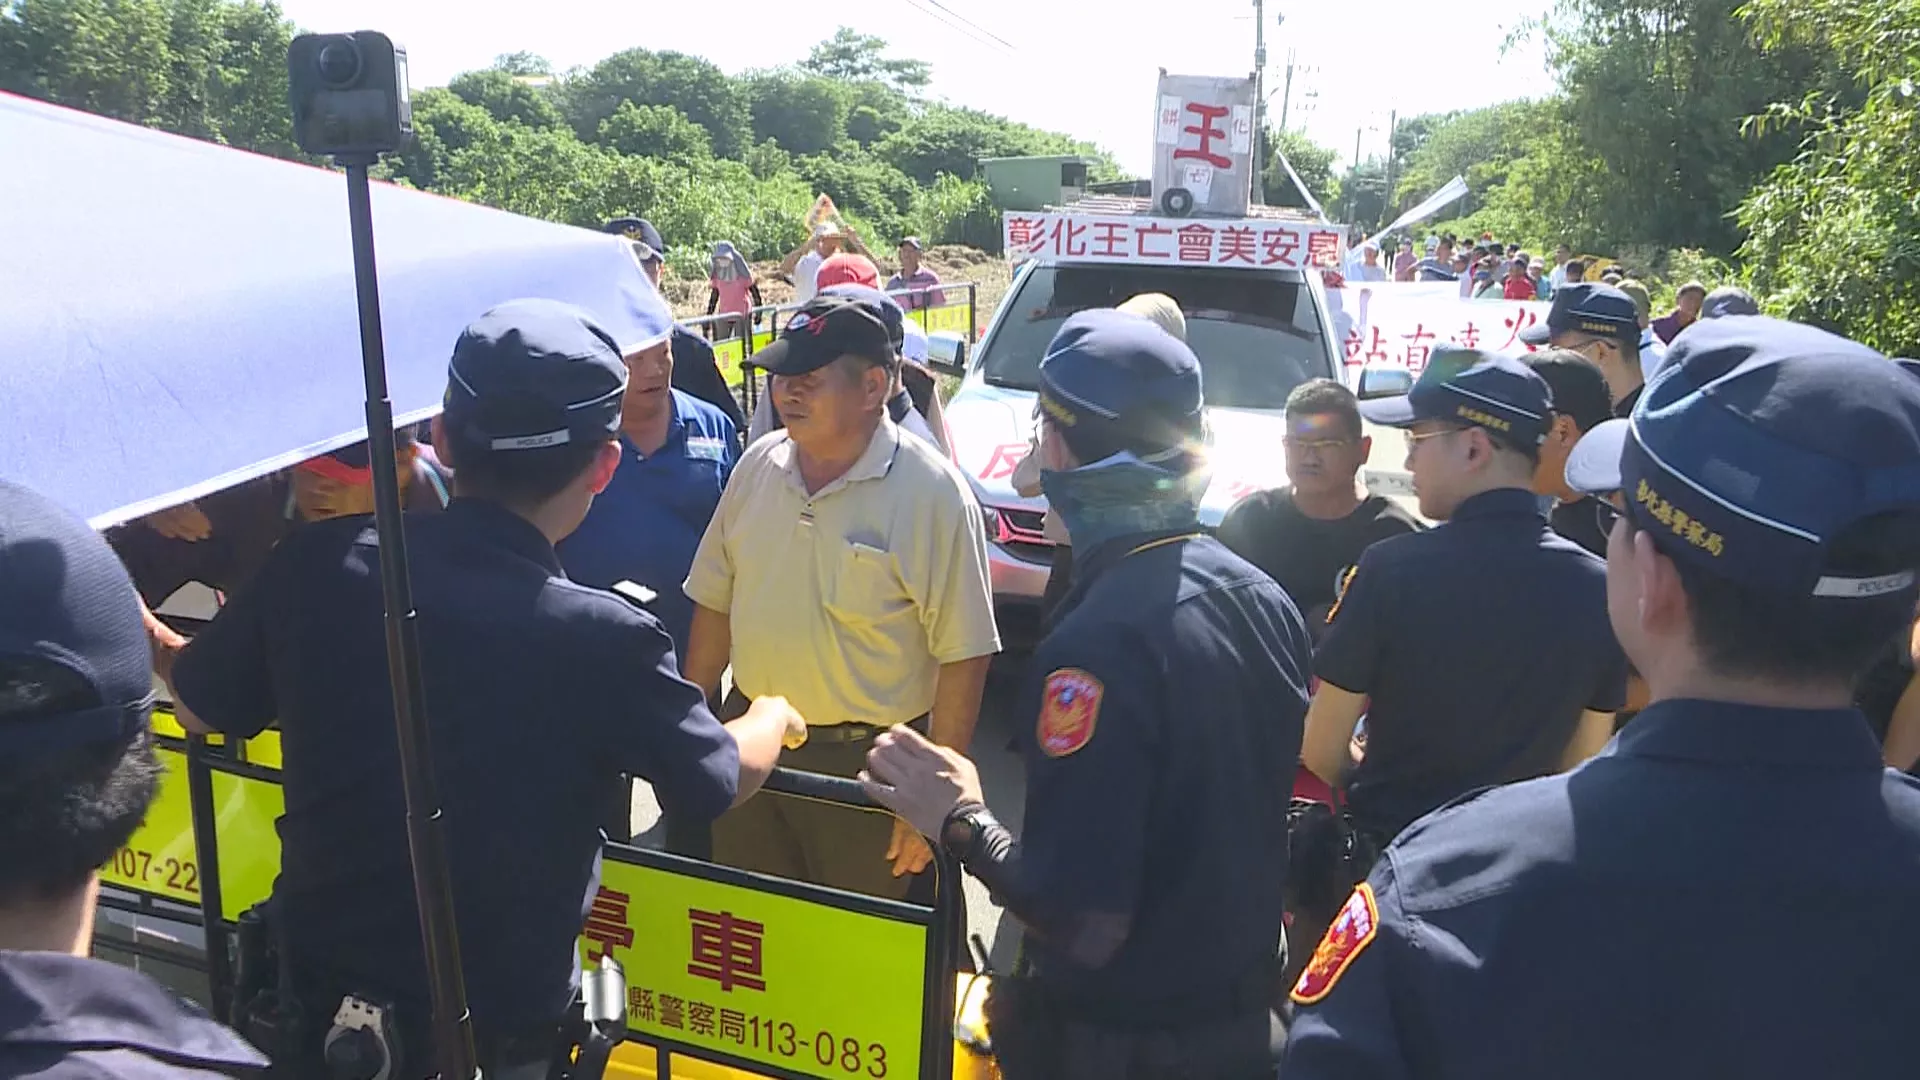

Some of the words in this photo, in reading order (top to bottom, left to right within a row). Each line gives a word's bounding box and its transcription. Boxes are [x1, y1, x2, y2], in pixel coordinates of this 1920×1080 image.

[1174, 102, 1232, 169] 王
[1008, 217, 1340, 268] 彰化王亡會美安息
